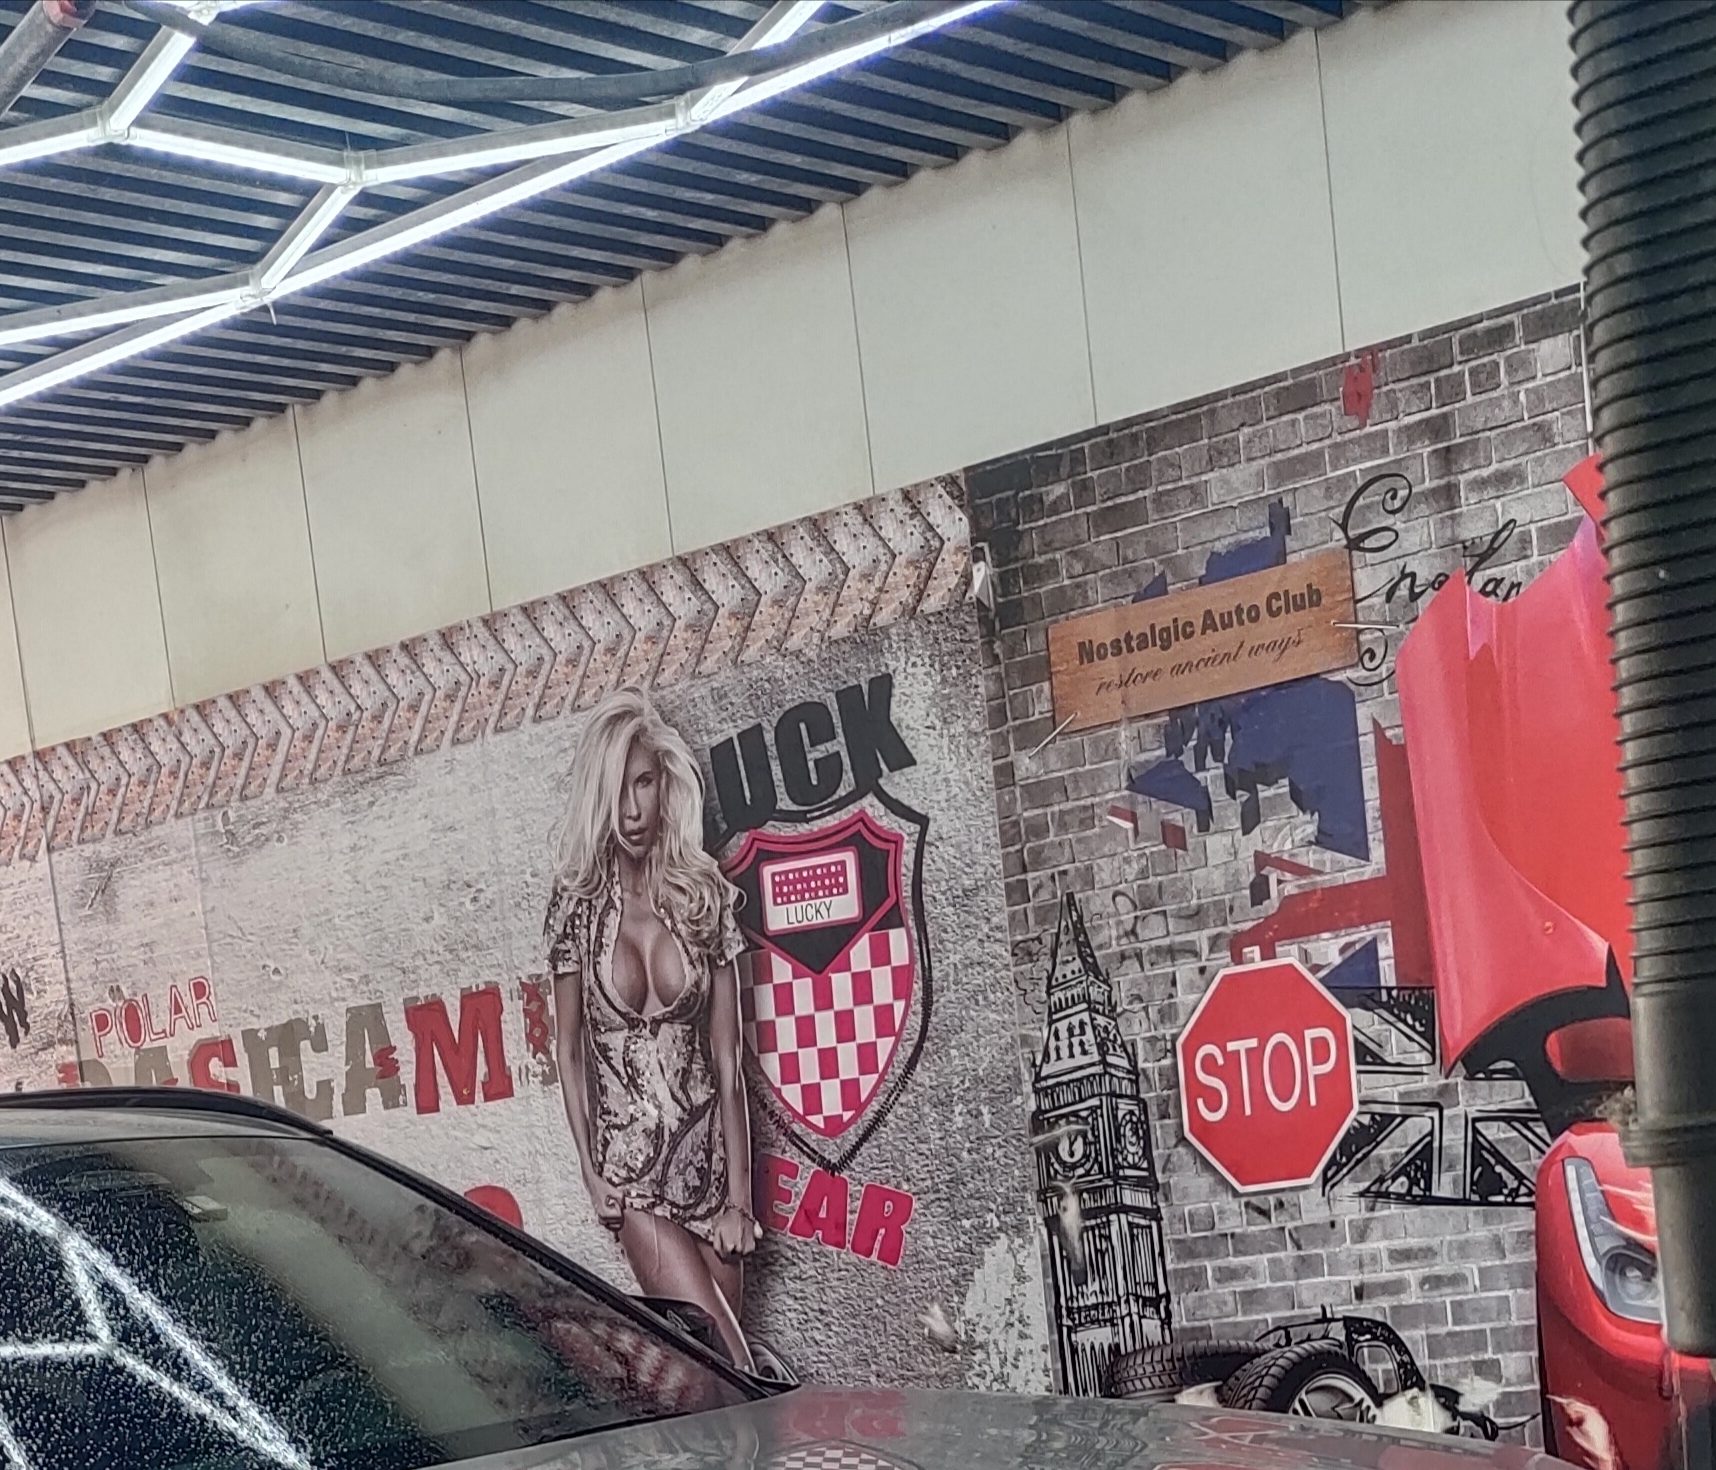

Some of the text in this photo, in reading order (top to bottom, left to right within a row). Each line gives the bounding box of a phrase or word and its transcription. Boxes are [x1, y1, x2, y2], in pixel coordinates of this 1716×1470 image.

[1077, 583, 1323, 666] Nostalgic Auto Club
[1094, 627, 1307, 696] restore ancient ways
[708, 672, 918, 836] UCK
[785, 900, 833, 925] LUCKY
[90, 975, 218, 1059] POLAR
[1194, 1027, 1337, 1122] STOP
